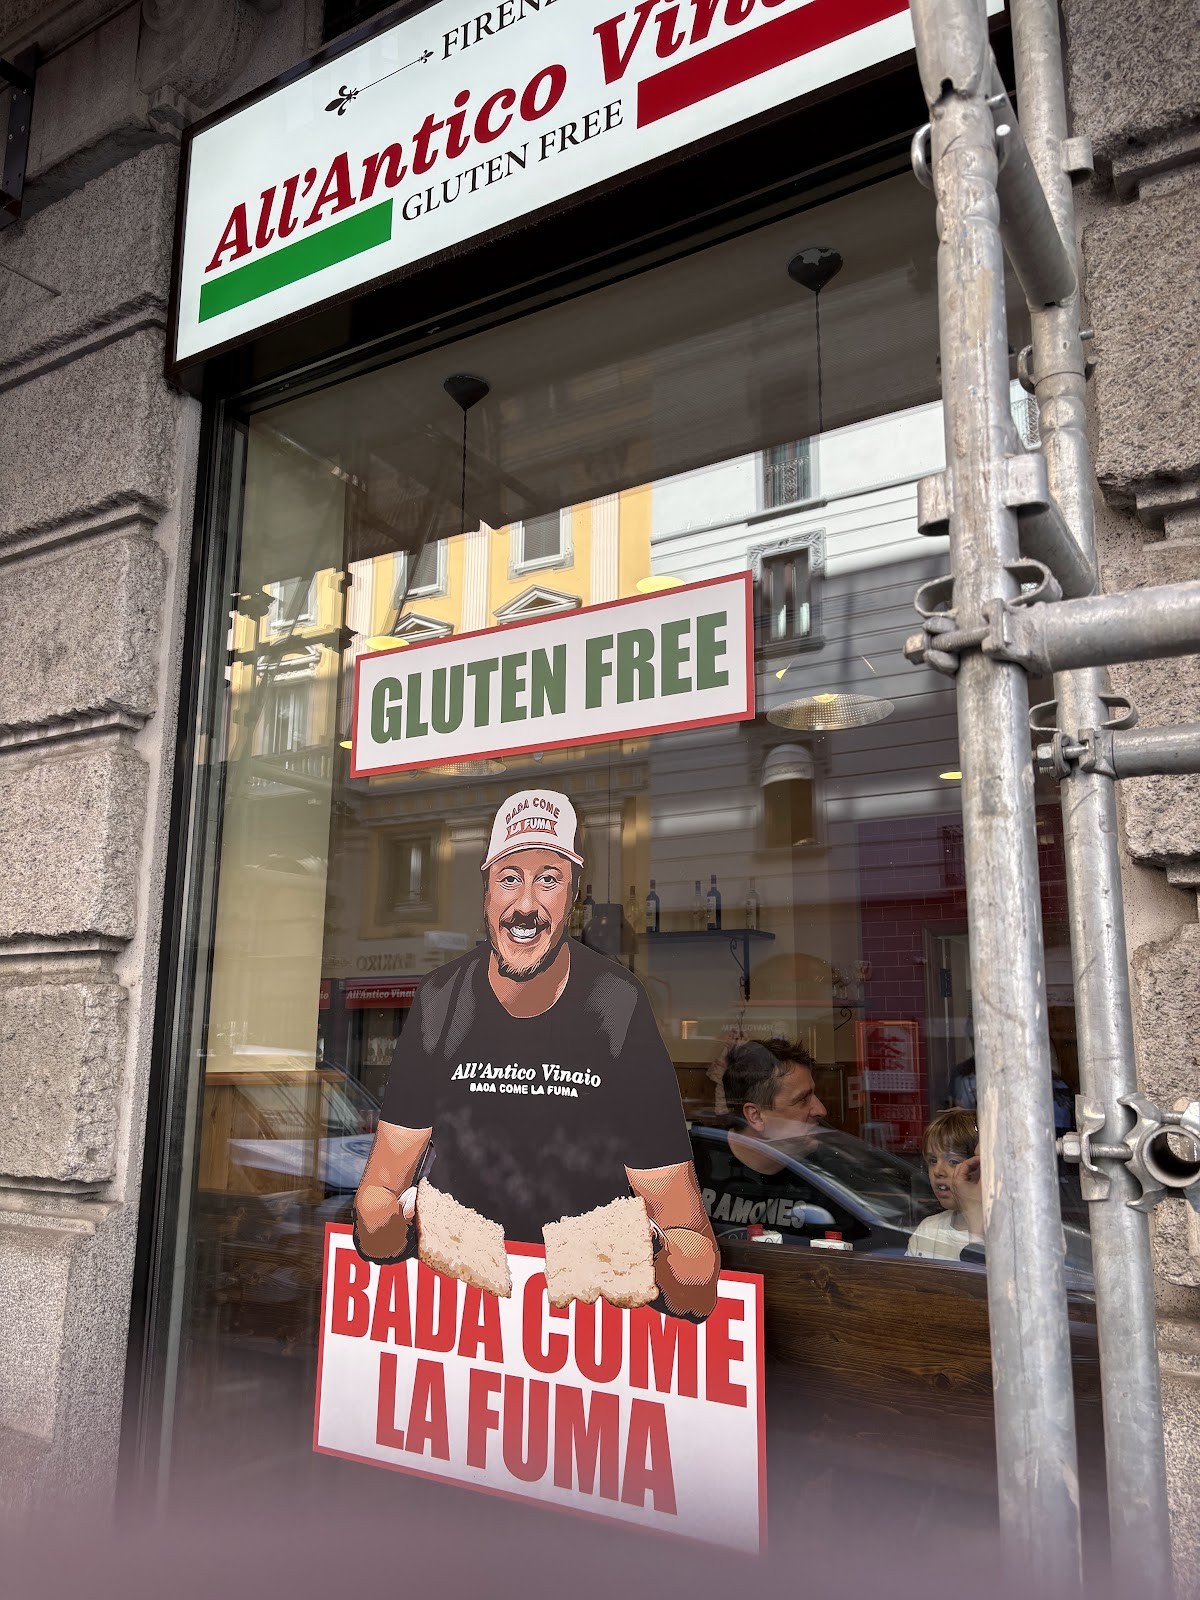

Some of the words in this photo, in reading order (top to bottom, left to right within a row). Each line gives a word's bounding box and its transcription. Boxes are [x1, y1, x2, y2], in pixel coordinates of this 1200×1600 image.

[442, 0, 559, 60] FIREN
[204, 64, 567, 274] All'Antico
[402, 142, 530, 221] GLUTEN
[537, 99, 624, 161] FREE
[370, 643, 567, 744] GLUTEN
[585, 610, 729, 710] FREE
[524, 818, 552, 831] FUMA
[532, 797, 561, 819] COME
[451, 1063, 537, 1081] All'Antico
[542, 1063, 602, 1088] Vinaio
[469, 1083, 497, 1093] BADA
[499, 1084, 529, 1095] COME
[531, 1085, 545, 1095] LA
[547, 1085, 579, 1098] FUMA
[701, 1187, 807, 1229] RAMONES
[331, 1247, 504, 1364] BADA
[522, 1272, 748, 1409] COME
[375, 1351, 451, 1462] LA
[466, 1367, 679, 1516] FUMA
